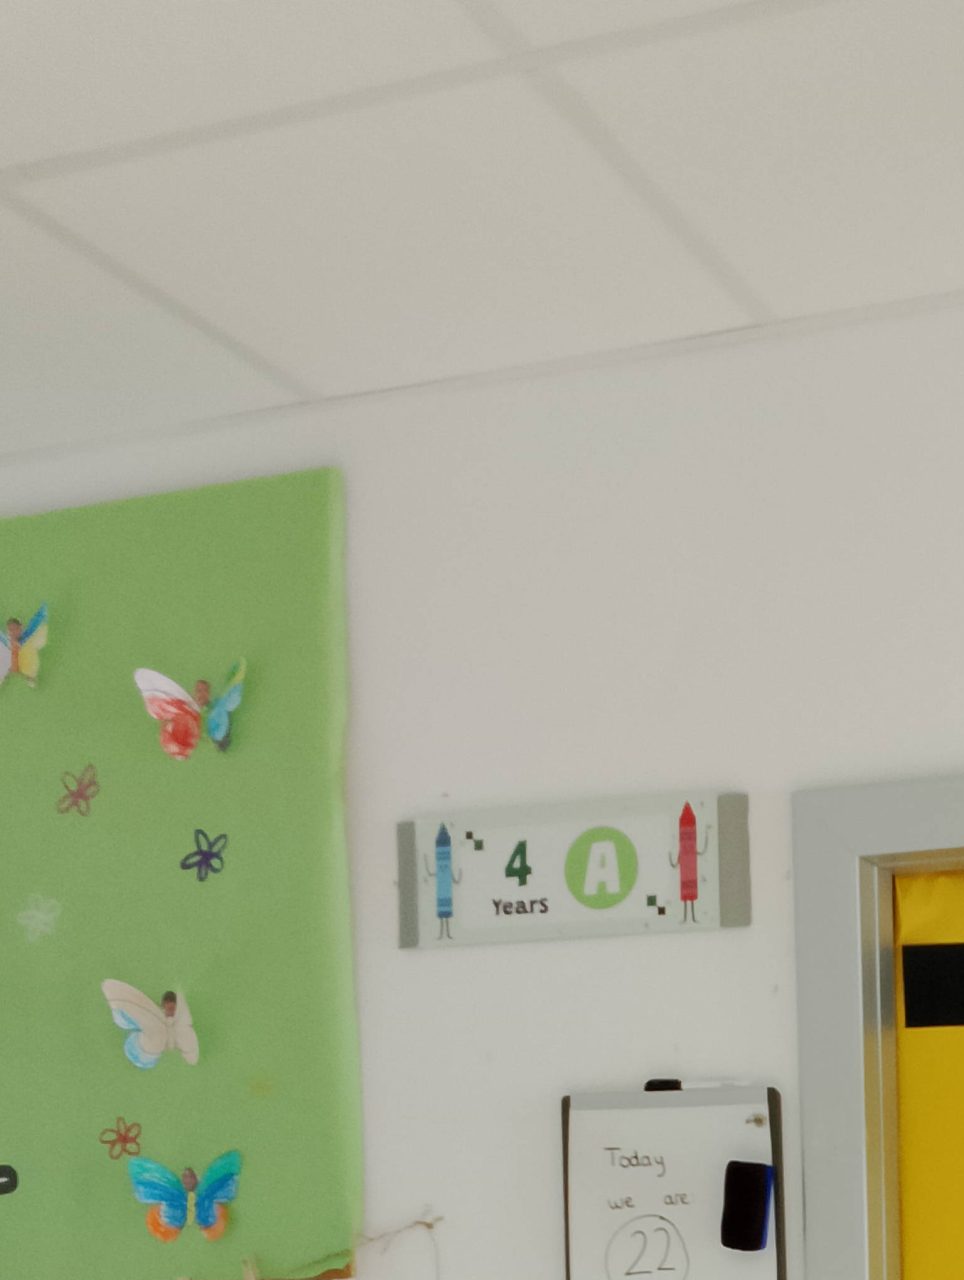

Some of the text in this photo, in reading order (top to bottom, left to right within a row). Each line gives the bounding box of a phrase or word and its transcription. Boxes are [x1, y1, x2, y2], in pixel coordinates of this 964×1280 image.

[505, 840, 532, 887] 4
[583, 840, 621, 897] A
[491, 897, 549, 916] Years
[603, 1146, 666, 1178] Today
[607, 1192, 690, 1211] we are
[624, 1226, 676, 1276] 22
